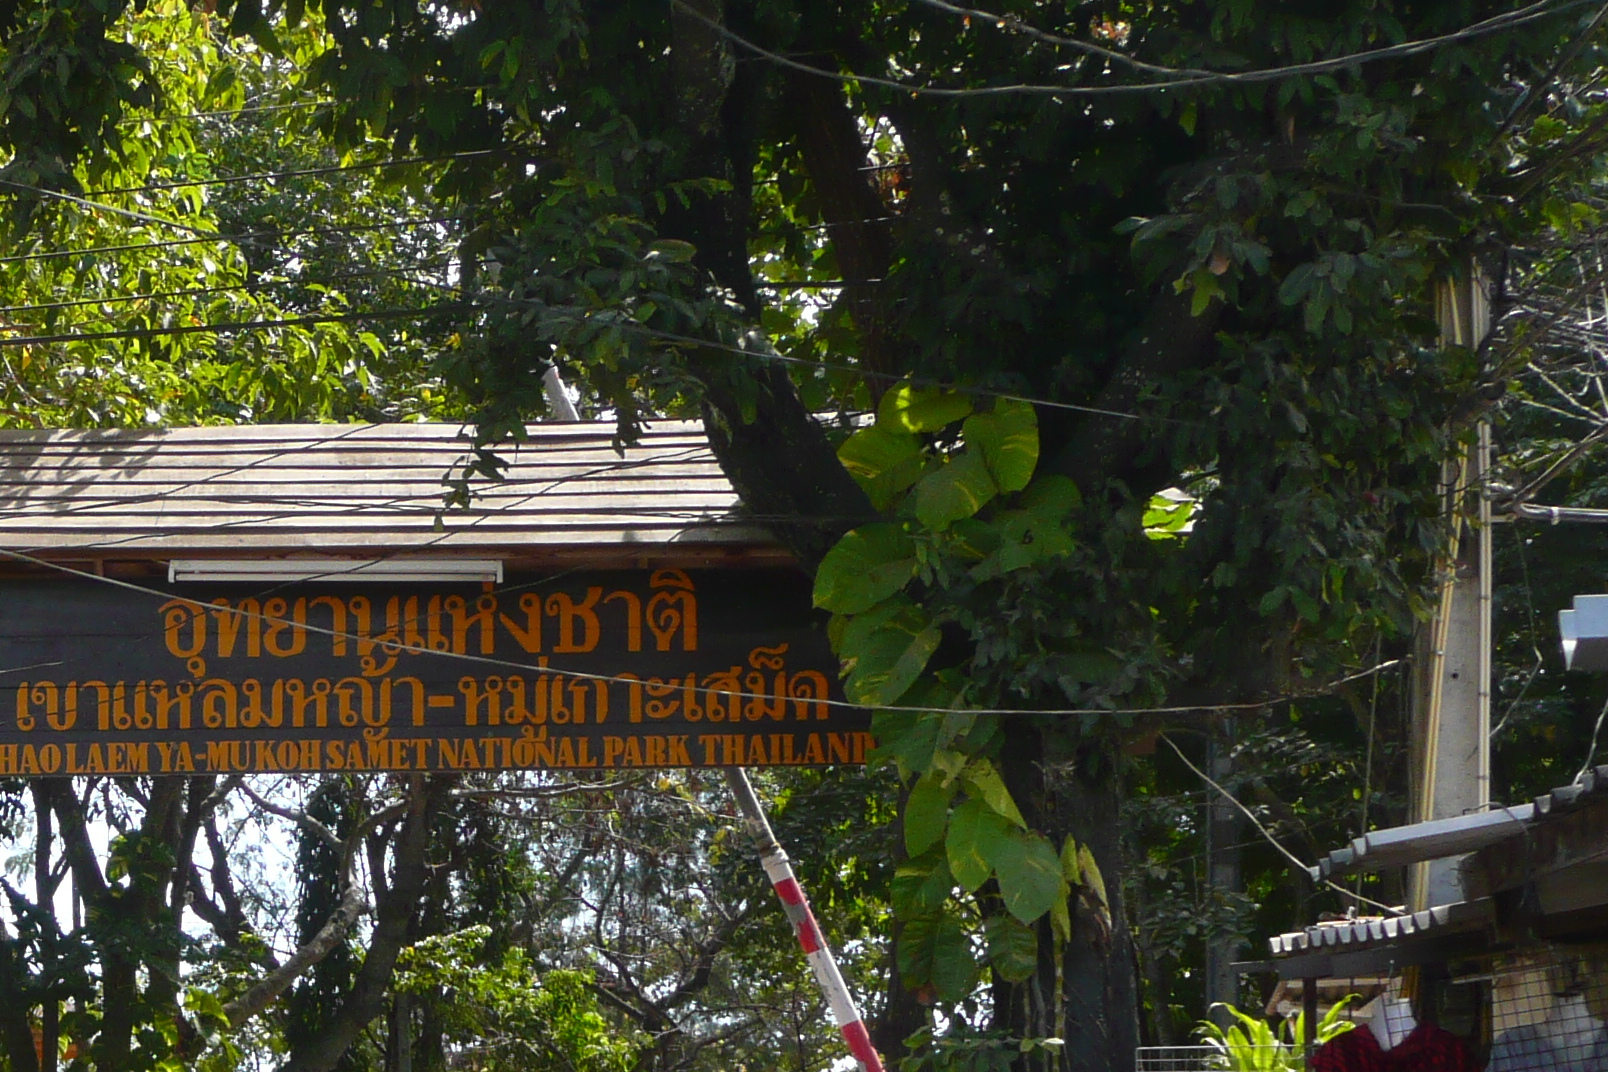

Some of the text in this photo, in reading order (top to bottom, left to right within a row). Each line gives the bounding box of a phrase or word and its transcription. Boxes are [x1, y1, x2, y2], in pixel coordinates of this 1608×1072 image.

[158, 570, 698, 678] อุทยานแห่งชาติ
[66, 742, 149, 773] LAEM
[255, 739, 321, 770] KOH
[326, 738, 432, 770] SAMET
[438, 737, 596, 768] NATIONAL
[602, 735, 691, 767] PARK
